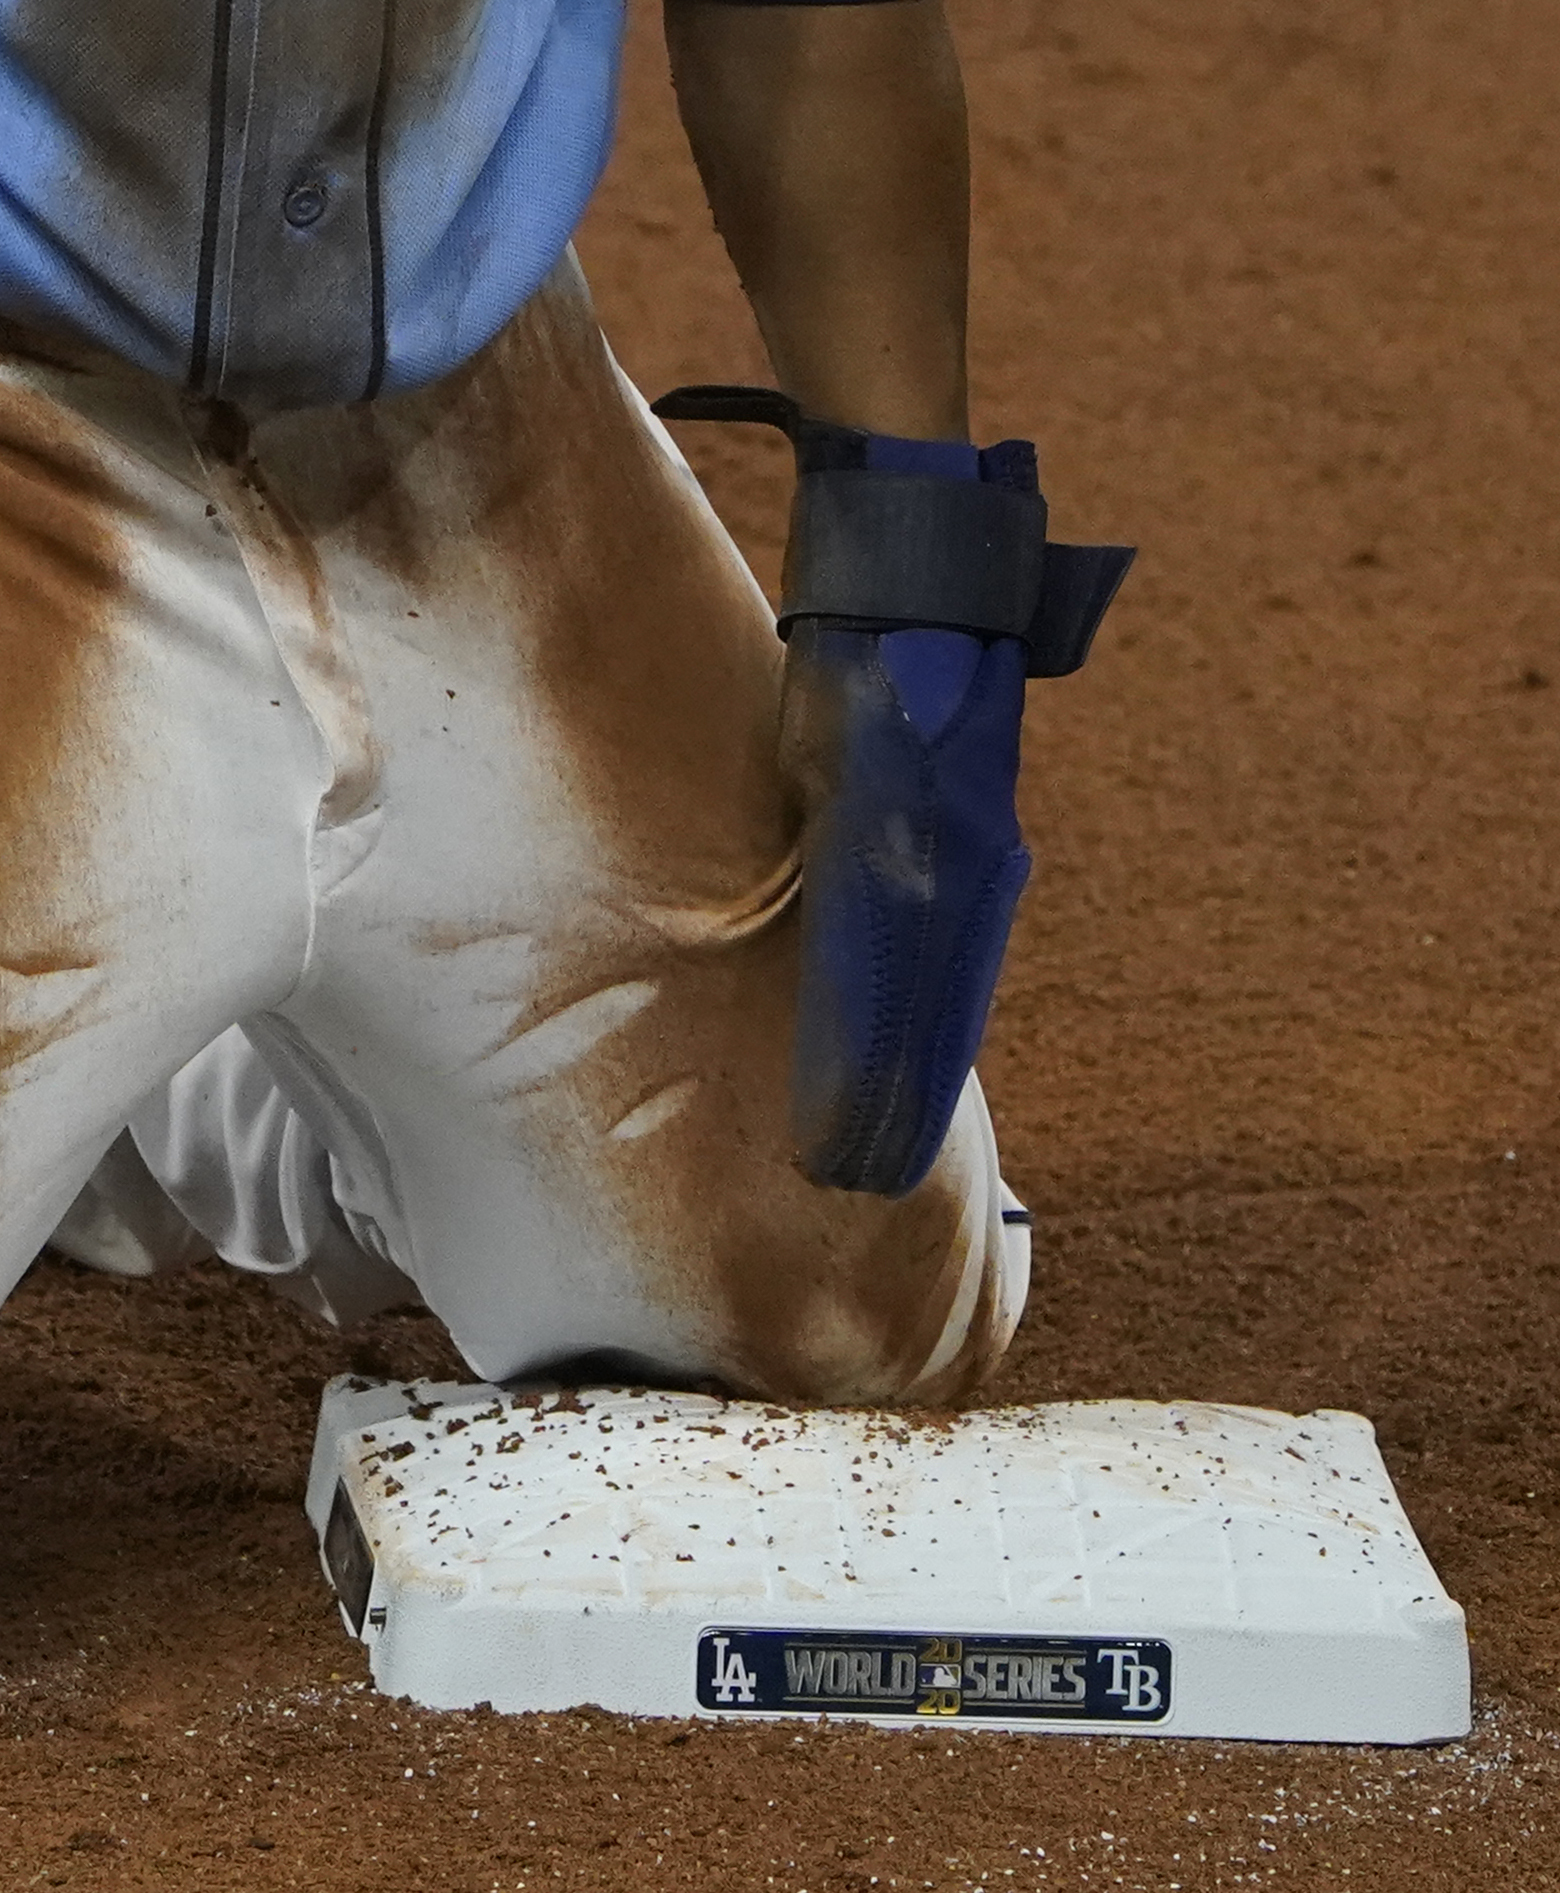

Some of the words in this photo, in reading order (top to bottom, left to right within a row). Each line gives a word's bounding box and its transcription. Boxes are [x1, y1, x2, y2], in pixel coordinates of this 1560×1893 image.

[711, 1637, 757, 1702] LA
[784, 1649, 917, 1697] WORLD
[963, 1654, 1087, 1702] SERIES
[919, 1637, 963, 1663] 20
[916, 1688, 961, 1715] 20
[1096, 1648, 1162, 1712] TB
